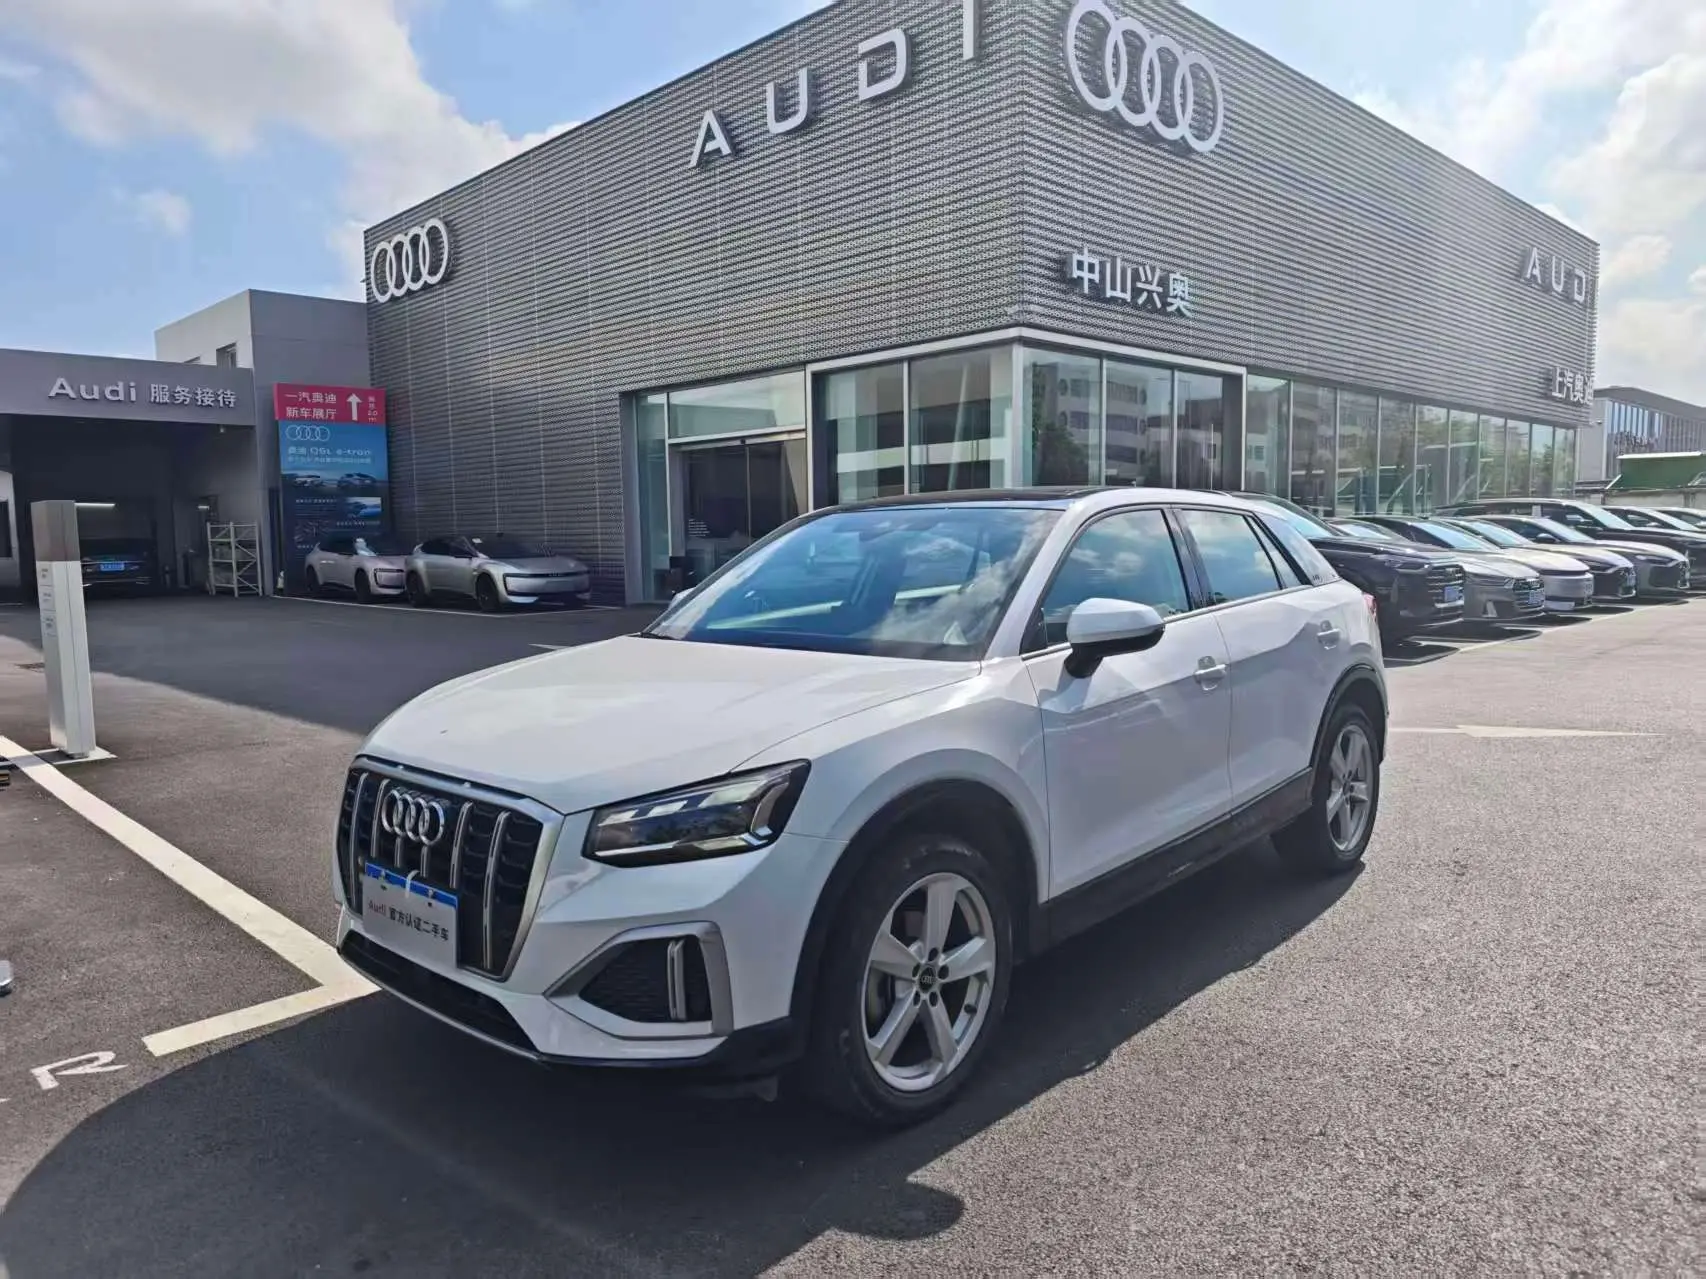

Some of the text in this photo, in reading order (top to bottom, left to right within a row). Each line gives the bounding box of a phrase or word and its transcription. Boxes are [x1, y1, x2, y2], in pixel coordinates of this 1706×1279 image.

[689, 0, 975, 168] AUDI
[1072, 245, 1194, 318] 中山兴奥
[48, 377, 237, 408] Audi 服务接待
[285, 391, 337, 404] 一汽奥迪
[286, 406, 337, 420] 新车展厅
